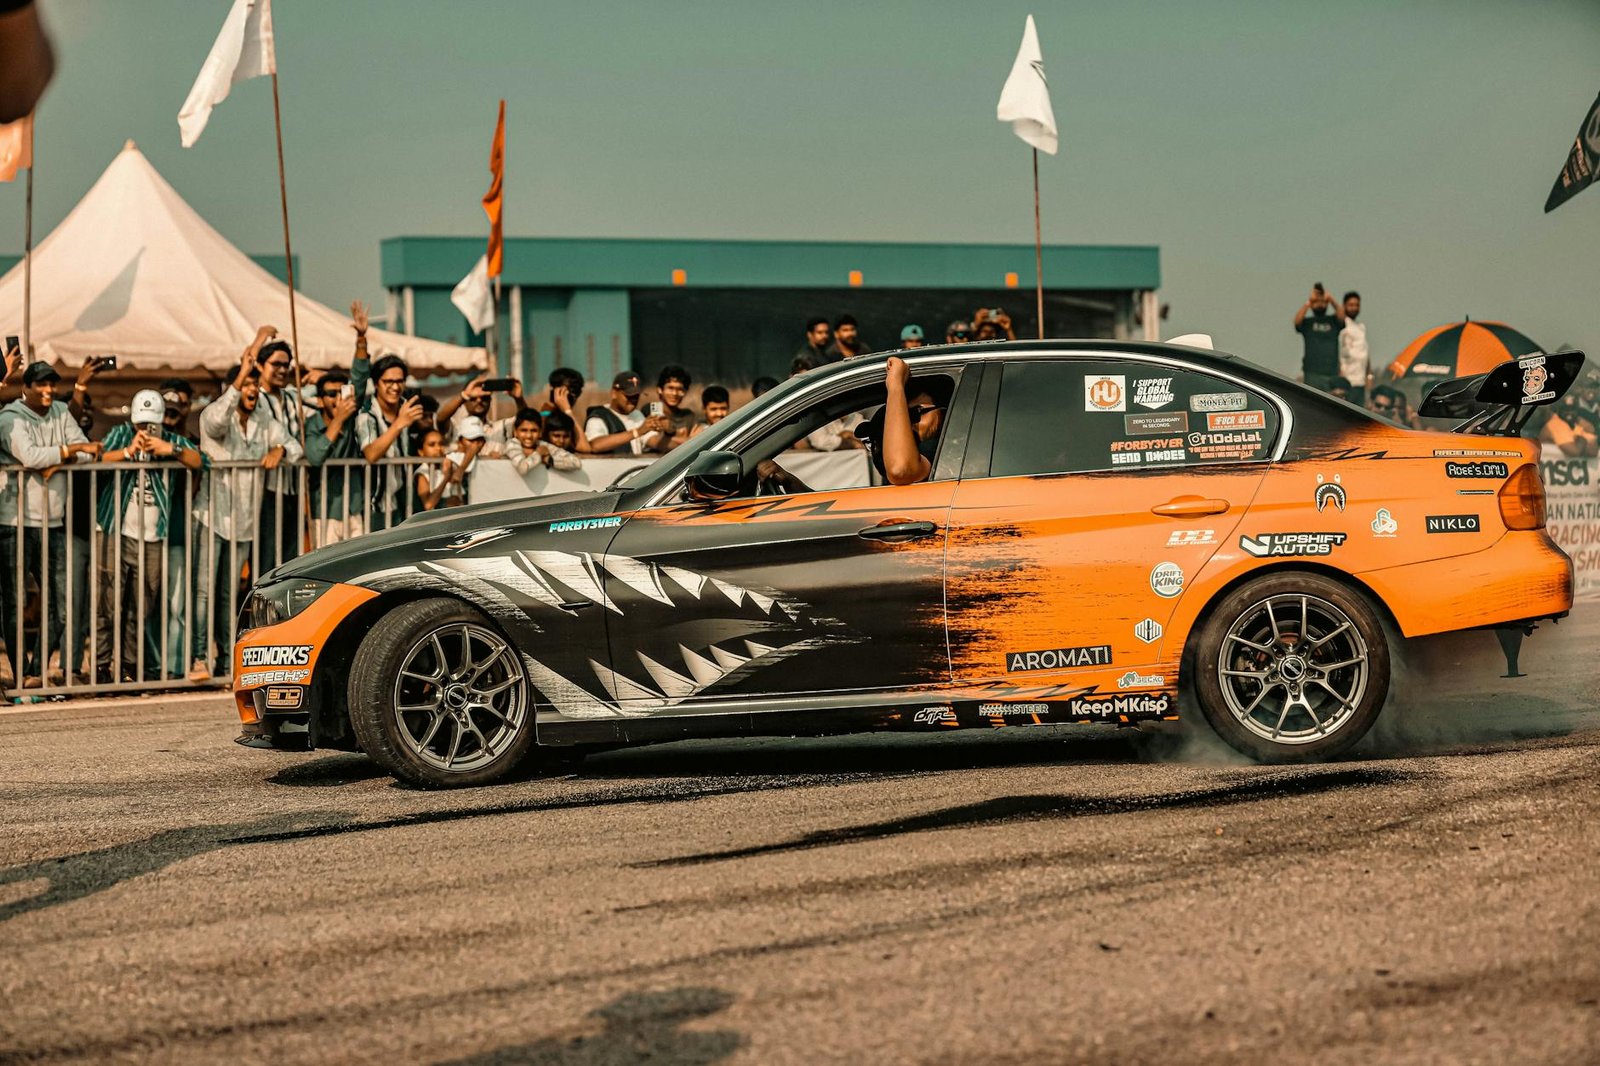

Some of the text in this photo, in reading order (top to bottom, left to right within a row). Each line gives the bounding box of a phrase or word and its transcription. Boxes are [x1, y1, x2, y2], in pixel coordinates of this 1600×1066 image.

[1137, 377, 1173, 387] SUPPORT
[1136, 386, 1171, 396] GLOBAL
[1133, 393, 1175, 404] WARMING
[1199, 397, 1243, 407] MONEY PIT
[1110, 438, 1184, 452] #FORBY3VER
[1111, 452, 1141, 464] SEND
[549, 516, 622, 533] FORBY3VER
[1429, 518, 1476, 530] NIKLO
[1274, 534, 1345, 545] UPSHIFT
[1271, 543, 1329, 555] AUTOS
[1155, 570, 1181, 579] DRIFT
[1155, 577, 1183, 588] KING
[242, 646, 309, 666] SPEEDWORKS
[1010, 646, 1108, 671] AROMATI
